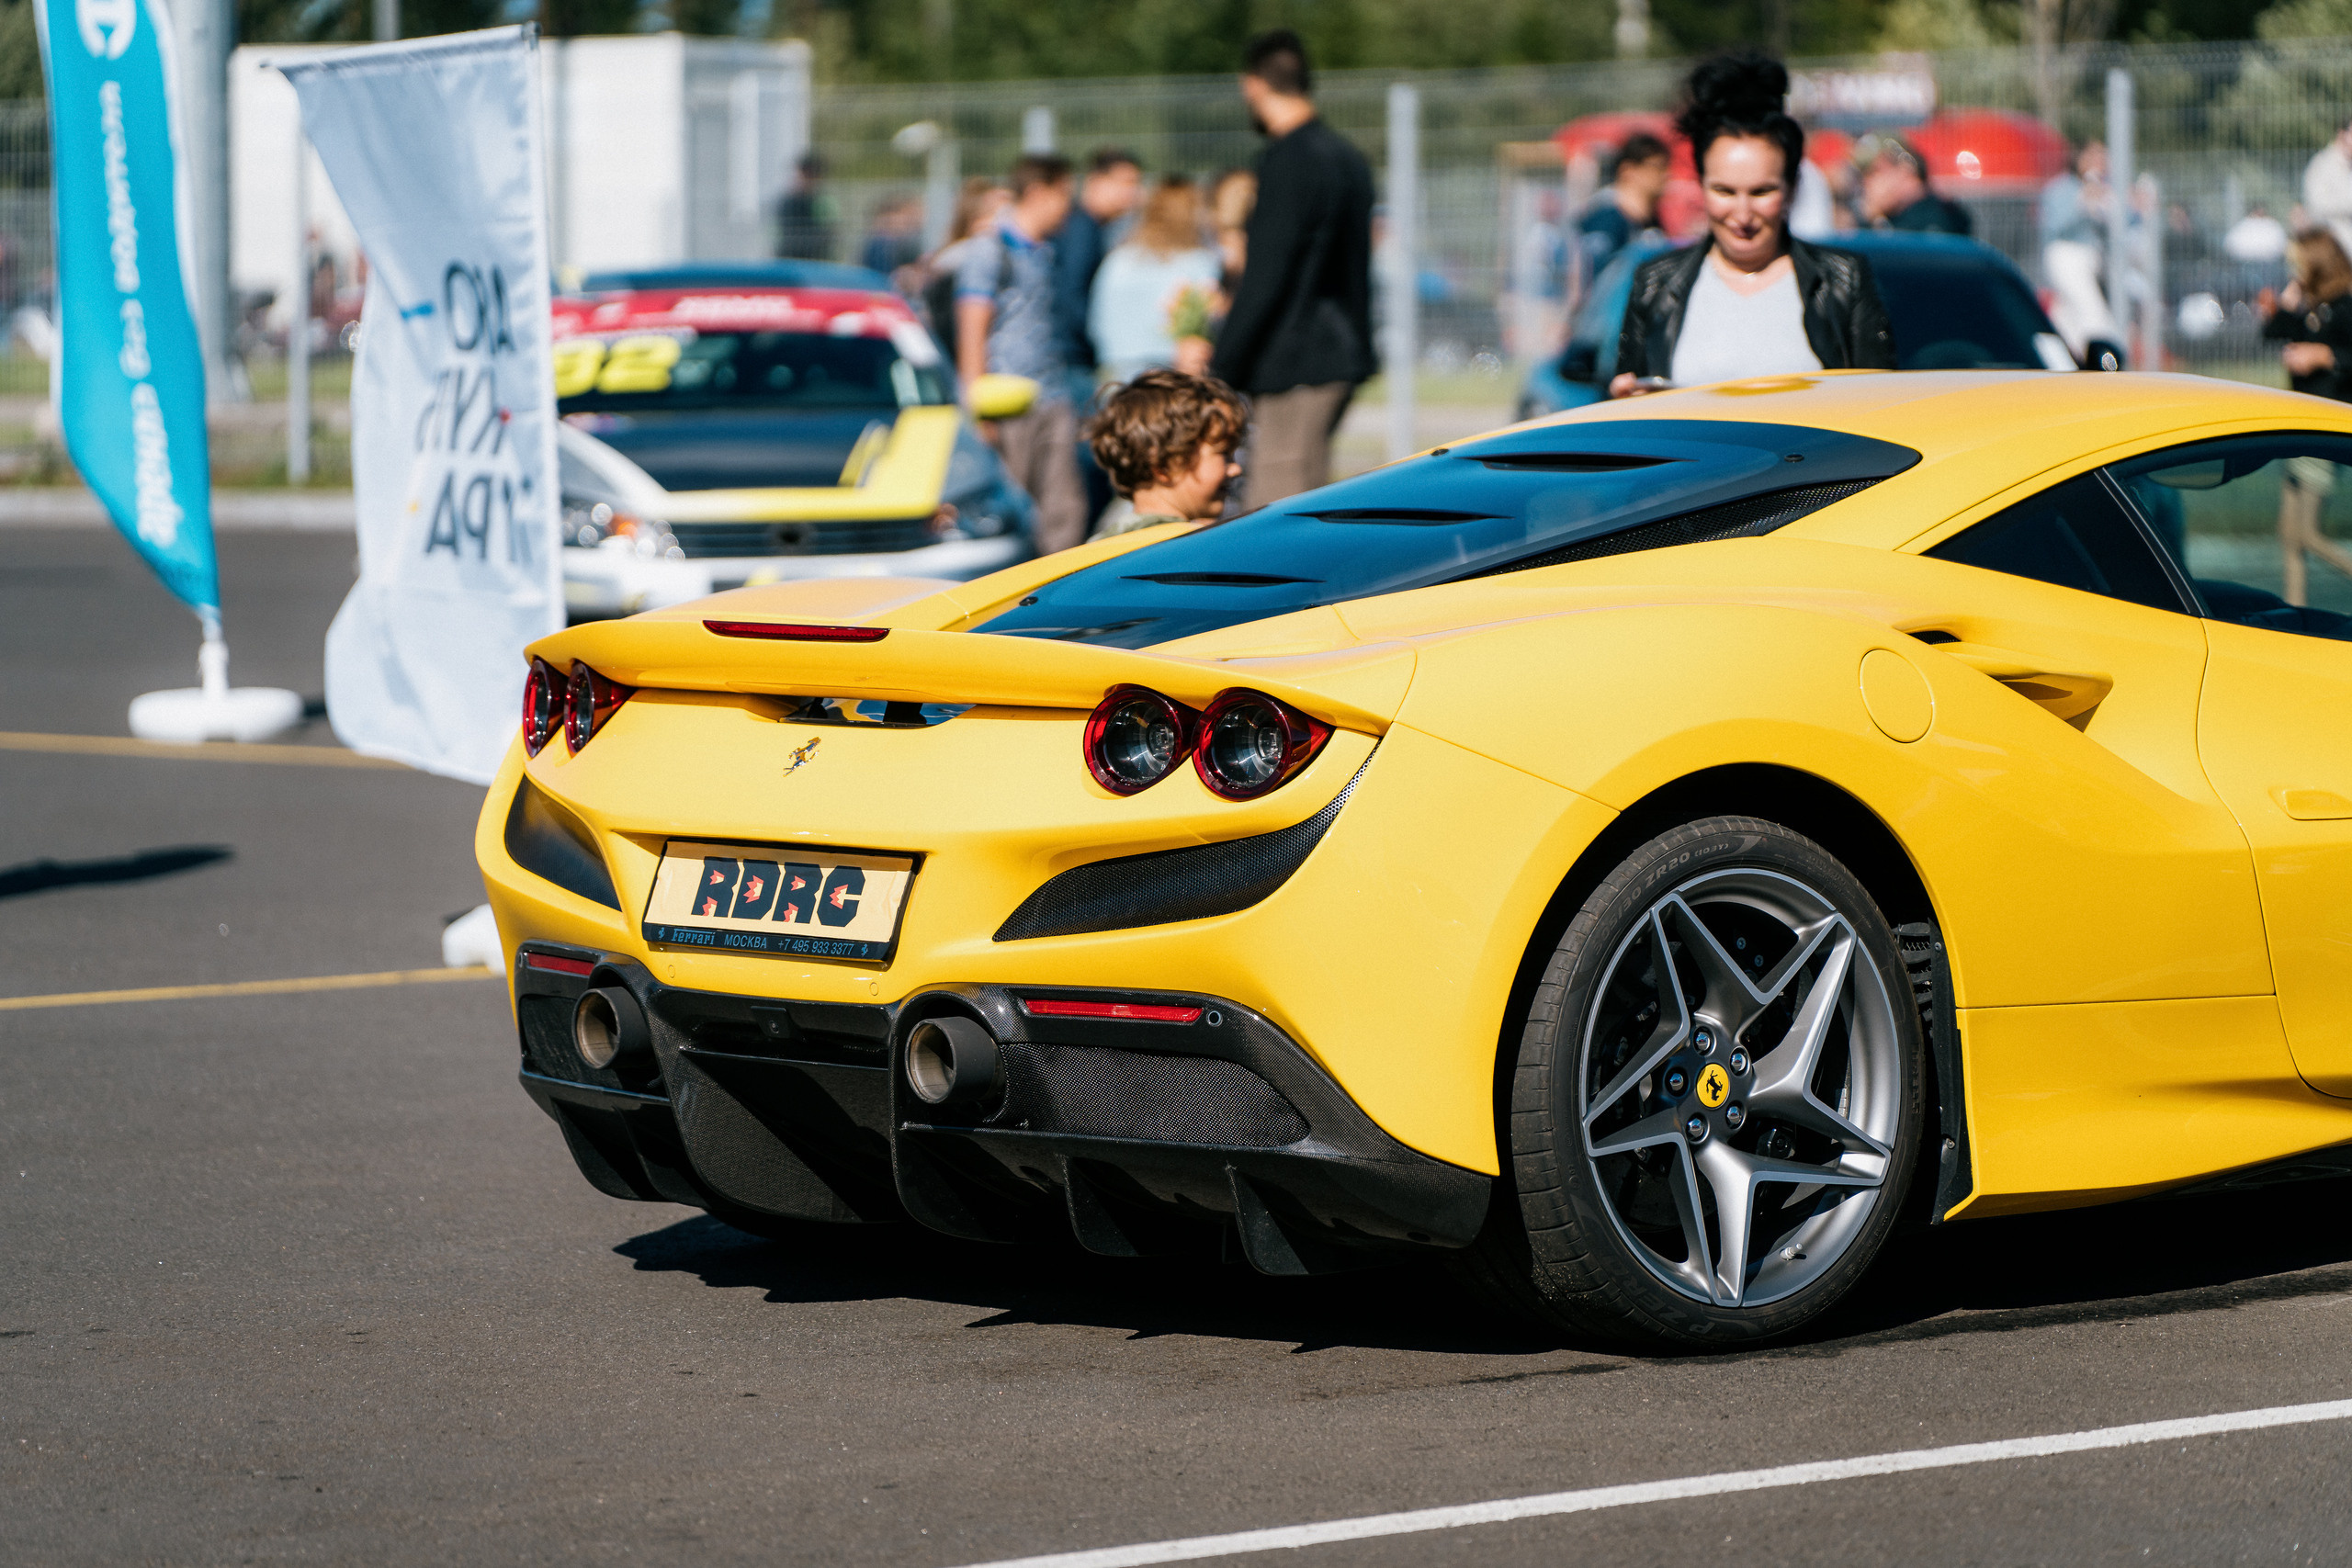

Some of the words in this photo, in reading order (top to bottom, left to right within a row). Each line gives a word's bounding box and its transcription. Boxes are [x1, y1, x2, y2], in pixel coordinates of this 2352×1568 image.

[1645, 852, 1690, 888] ZR20
[691, 855, 866, 928] RDRC
[672, 928, 716, 945] Ferrari
[724, 933, 767, 949] МОСКВА
[778, 938, 791, 951] +7
[792, 939, 809, 952] 495
[811, 941, 830, 953] 933
[831, 942, 854, 955] 3377
